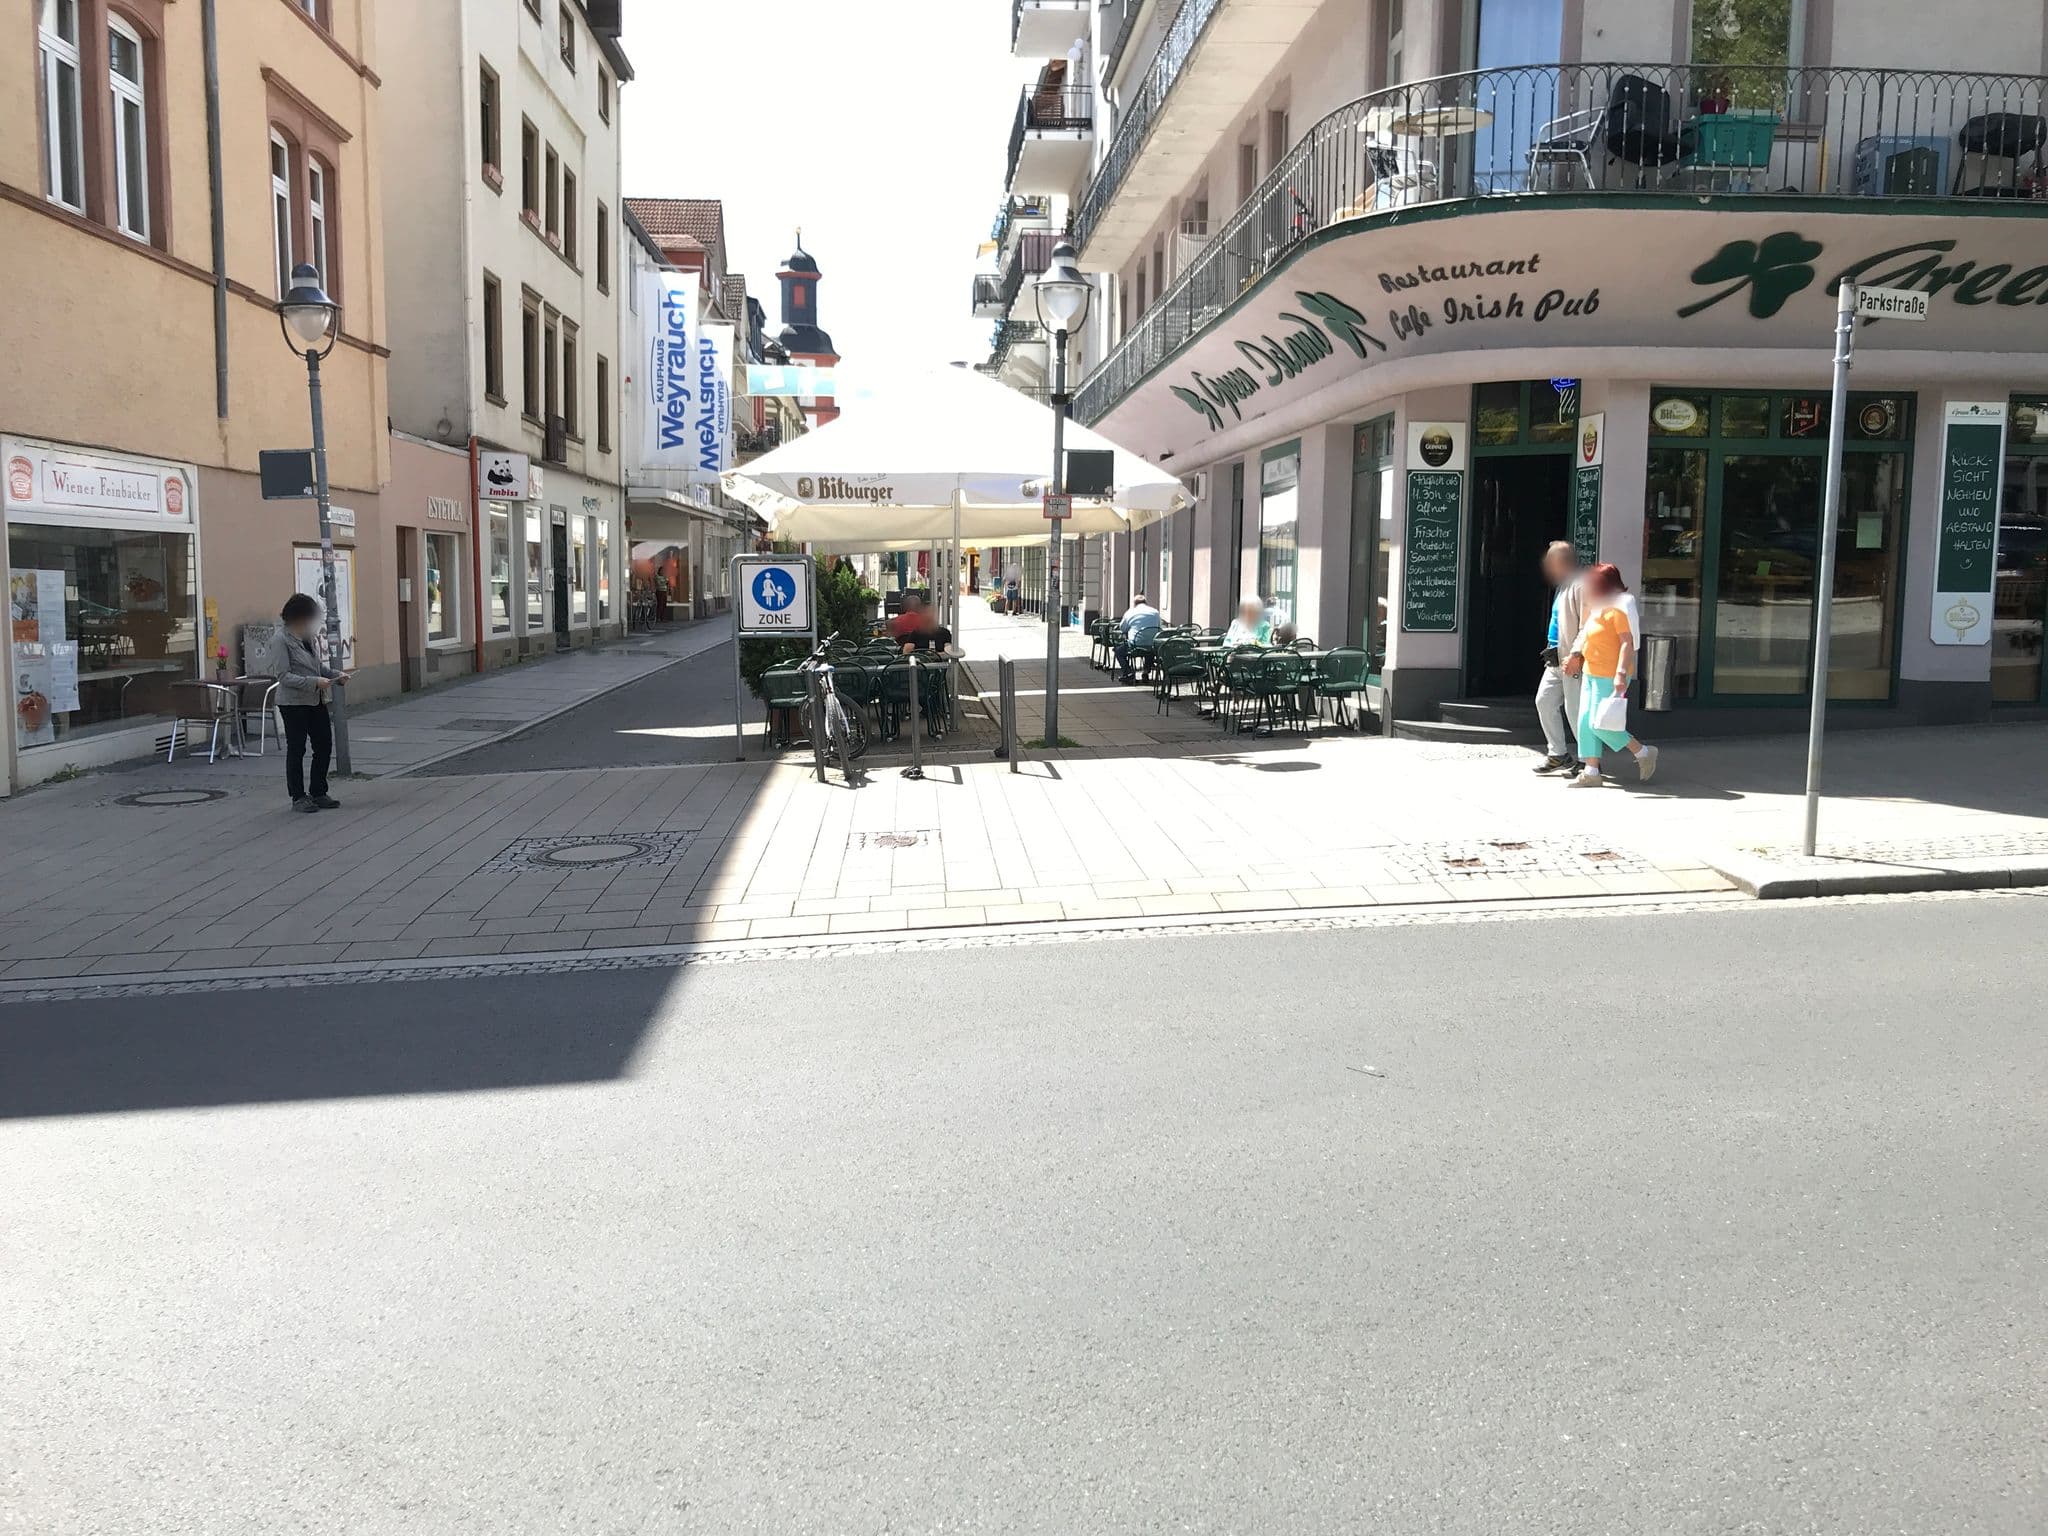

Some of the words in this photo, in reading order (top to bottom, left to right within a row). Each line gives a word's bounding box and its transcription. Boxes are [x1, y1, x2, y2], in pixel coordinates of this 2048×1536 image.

[1378, 252, 1541, 294] Restaurant
[1826, 239, 2048, 327] Gree
[1443, 292, 1524, 325] Irish
[1533, 287, 1601, 322] Pub
[1859, 291, 1925, 316] Parkstraße
[656, 338, 664, 403] KAUFHAUS
[661, 289, 691, 450] Weyrauch
[52, 470, 95, 496] Wiener
[100, 476, 151, 501] Feinbäcker
[489, 487, 519, 498] Imbiss
[818, 476, 894, 503] Bitburger
[1947, 488, 1992, 501] NEHMEN
[427, 496, 463, 523] ESTETICA
[1945, 522, 1994, 533] ABSTAND
[1953, 539, 1991, 551] HALTEN
[758, 613, 792, 625] ZONE
